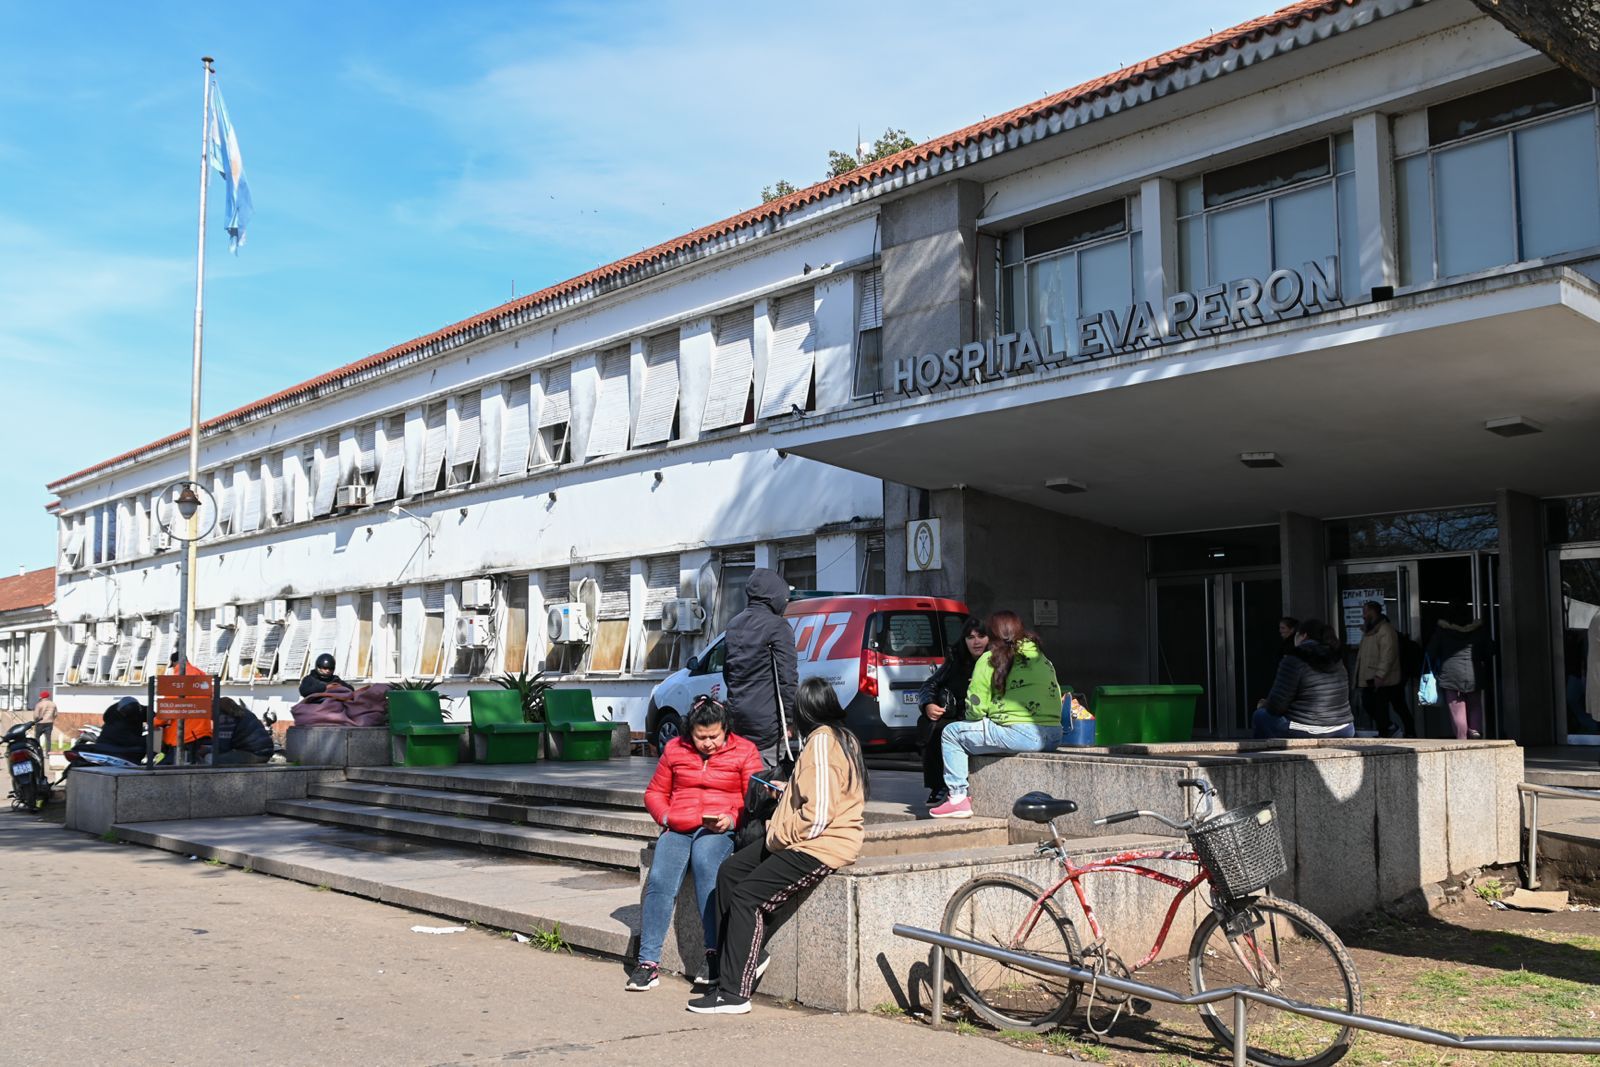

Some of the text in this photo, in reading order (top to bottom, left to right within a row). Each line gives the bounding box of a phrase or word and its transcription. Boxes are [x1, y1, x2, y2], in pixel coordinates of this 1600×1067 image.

[894, 255, 1339, 394] HOSPITAL EVA PERON
